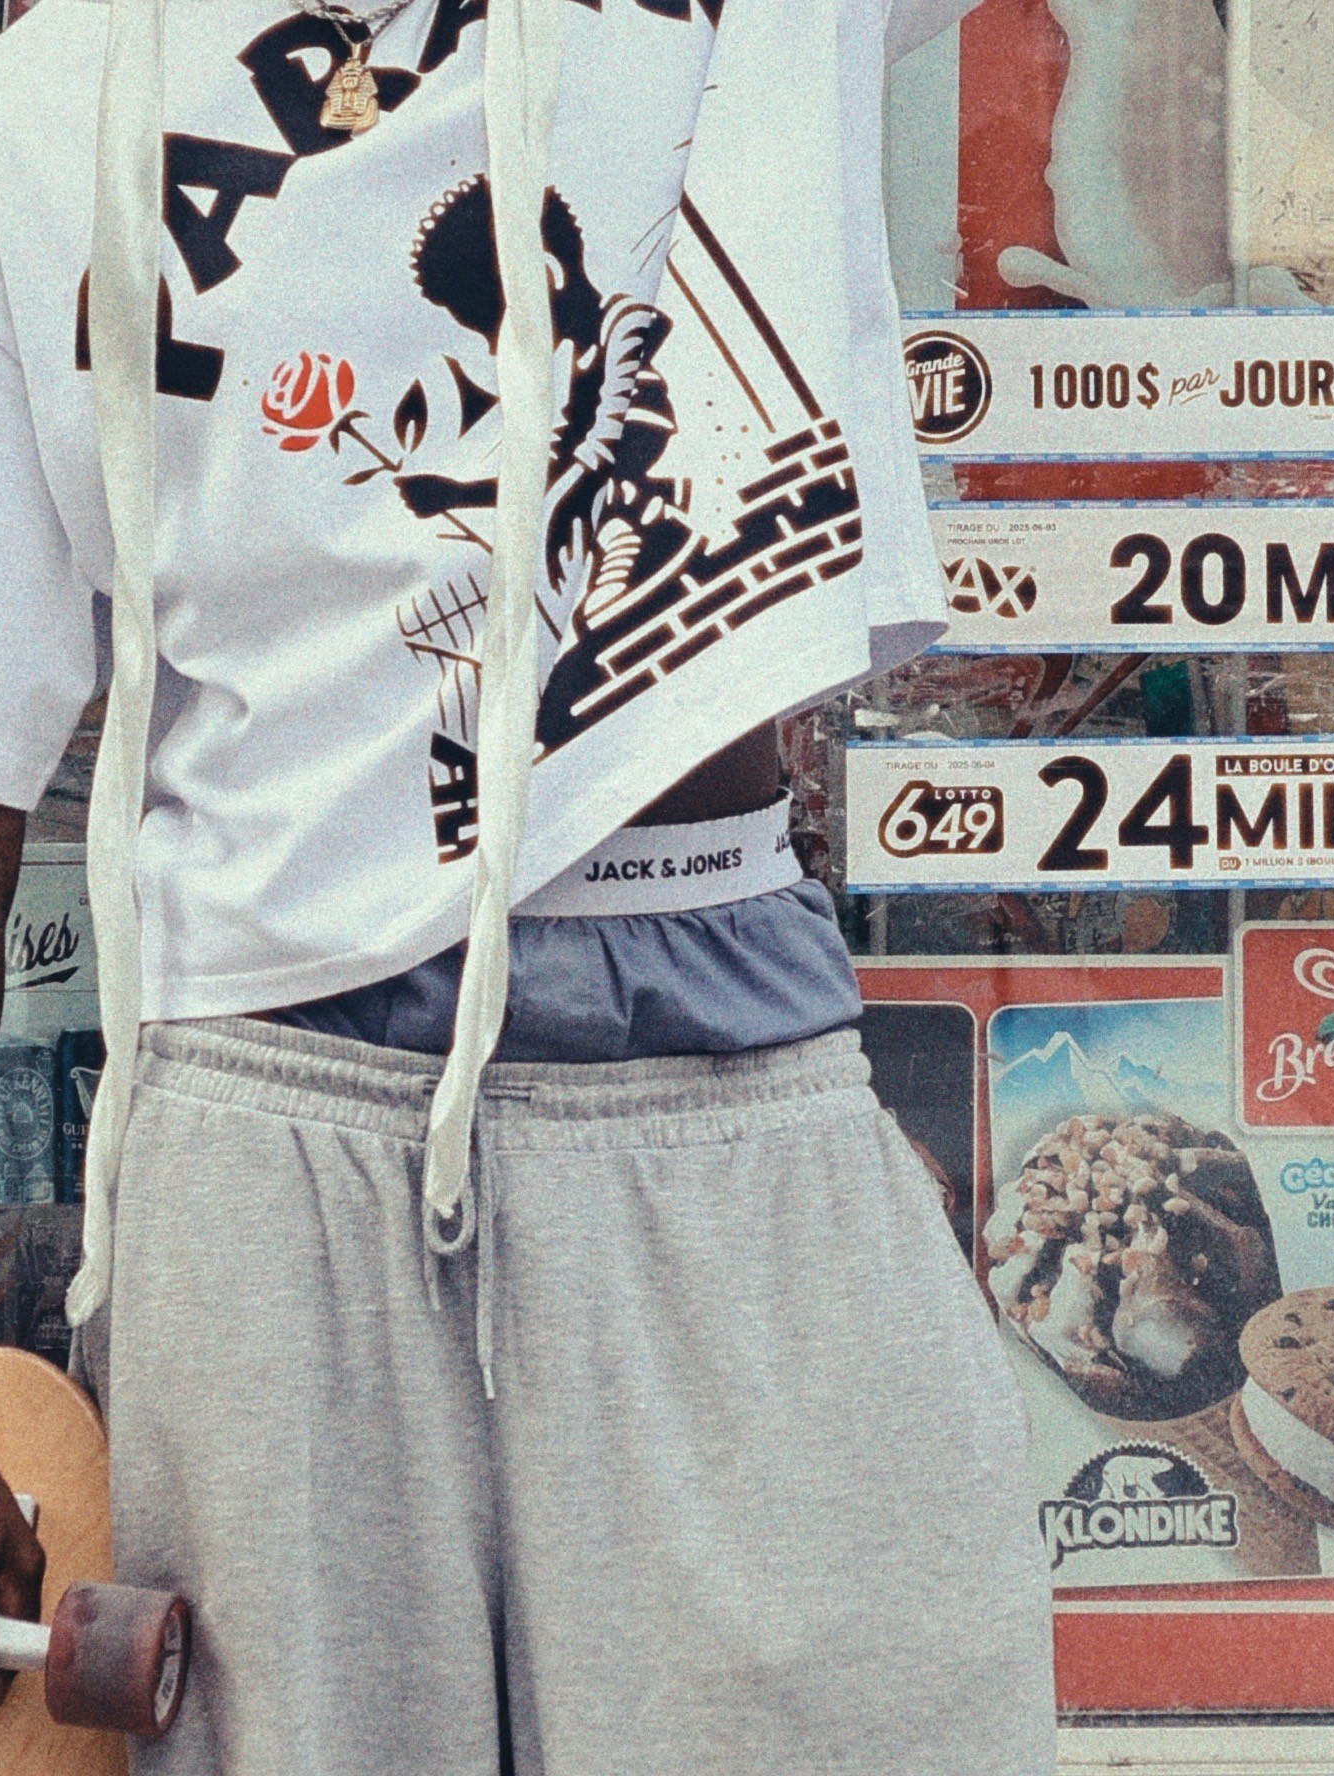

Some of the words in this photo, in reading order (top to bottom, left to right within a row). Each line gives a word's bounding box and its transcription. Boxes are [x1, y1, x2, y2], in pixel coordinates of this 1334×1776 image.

[905, 351, 966, 377] Grande
[906, 368, 967, 421] VIE
[1169, 366, 1220, 405] par
[947, 523, 984, 533] TIRAGE
[1109, 532, 1246, 626] 20
[885, 761, 922, 771] TIRAGE
[947, 760, 996, 770] 2025-06-04
[1223, 759, 1243, 774] LA
[1248, 758, 1303, 773] BOULE
[934, 788, 993, 801] LOTTO
[1036, 753, 1210, 872] 24
[584, 858, 656, 883] JACK
[660, 857, 677, 879] &
[680, 847, 743, 877] JONES
[1220, 859, 1237, 869] OU
[1252, 857, 1295, 866] MILLION
[1041, 1497, 1235, 1561] KLONDIKE
